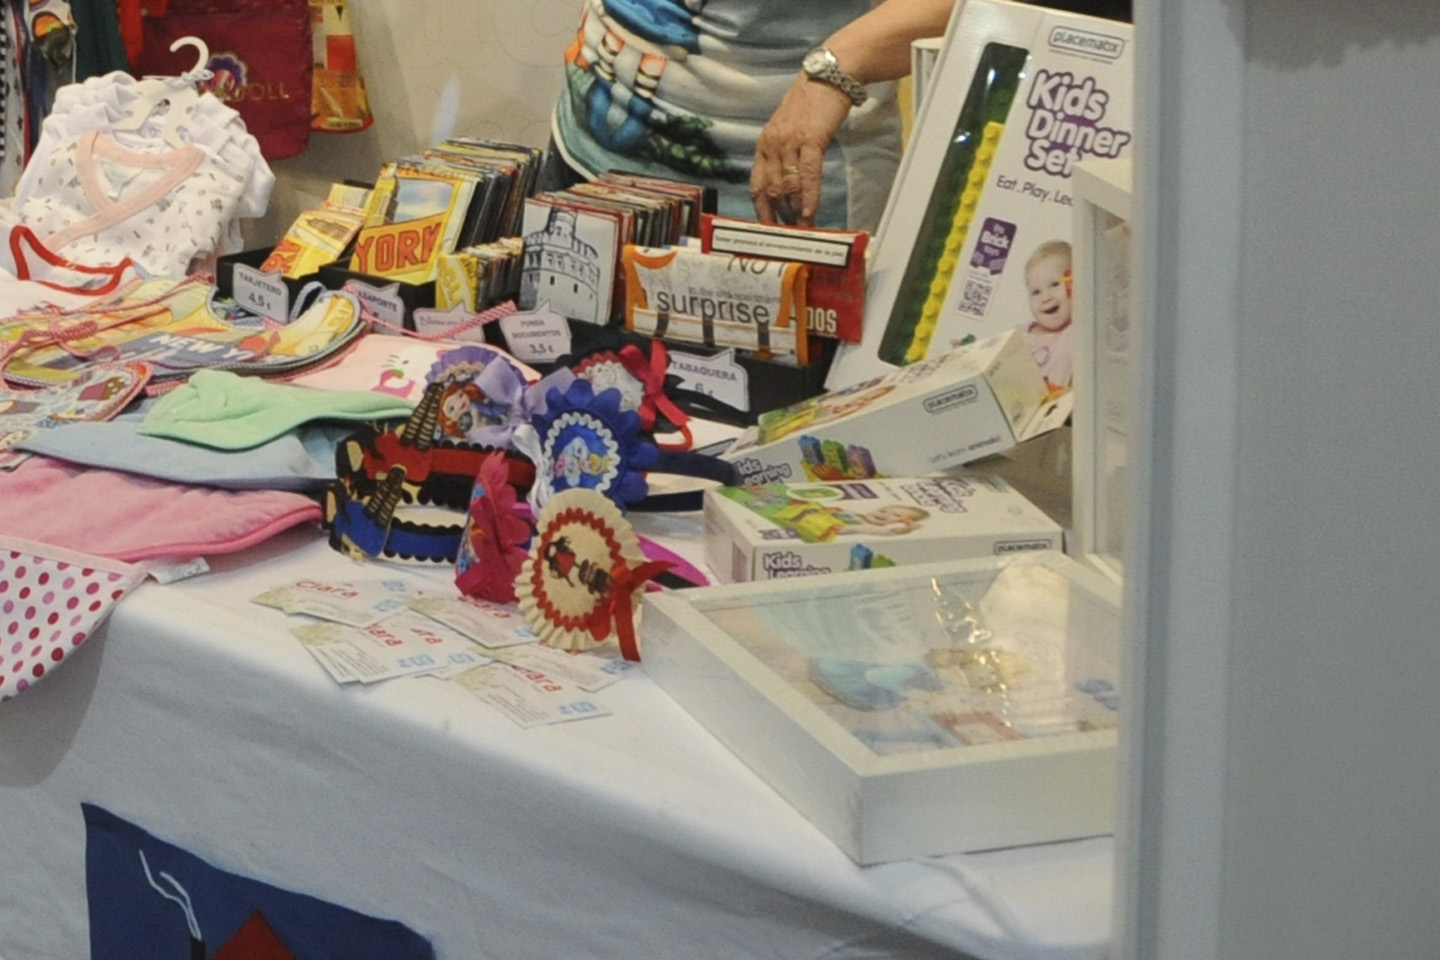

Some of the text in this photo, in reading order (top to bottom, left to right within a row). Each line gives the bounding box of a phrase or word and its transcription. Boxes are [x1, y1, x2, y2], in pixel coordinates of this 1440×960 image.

[1027, 69, 1109, 122] Kids
[1026, 109, 1131, 158] Dinner
[1025, 139, 1081, 178] Set
[656, 290, 770, 325] surprise
[672, 361, 737, 382] TABAQUERA
[737, 457, 763, 476] ids
[743, 463, 792, 486] earning
[763, 551, 802, 572] Kids
[296, 580, 359, 599] Clara
